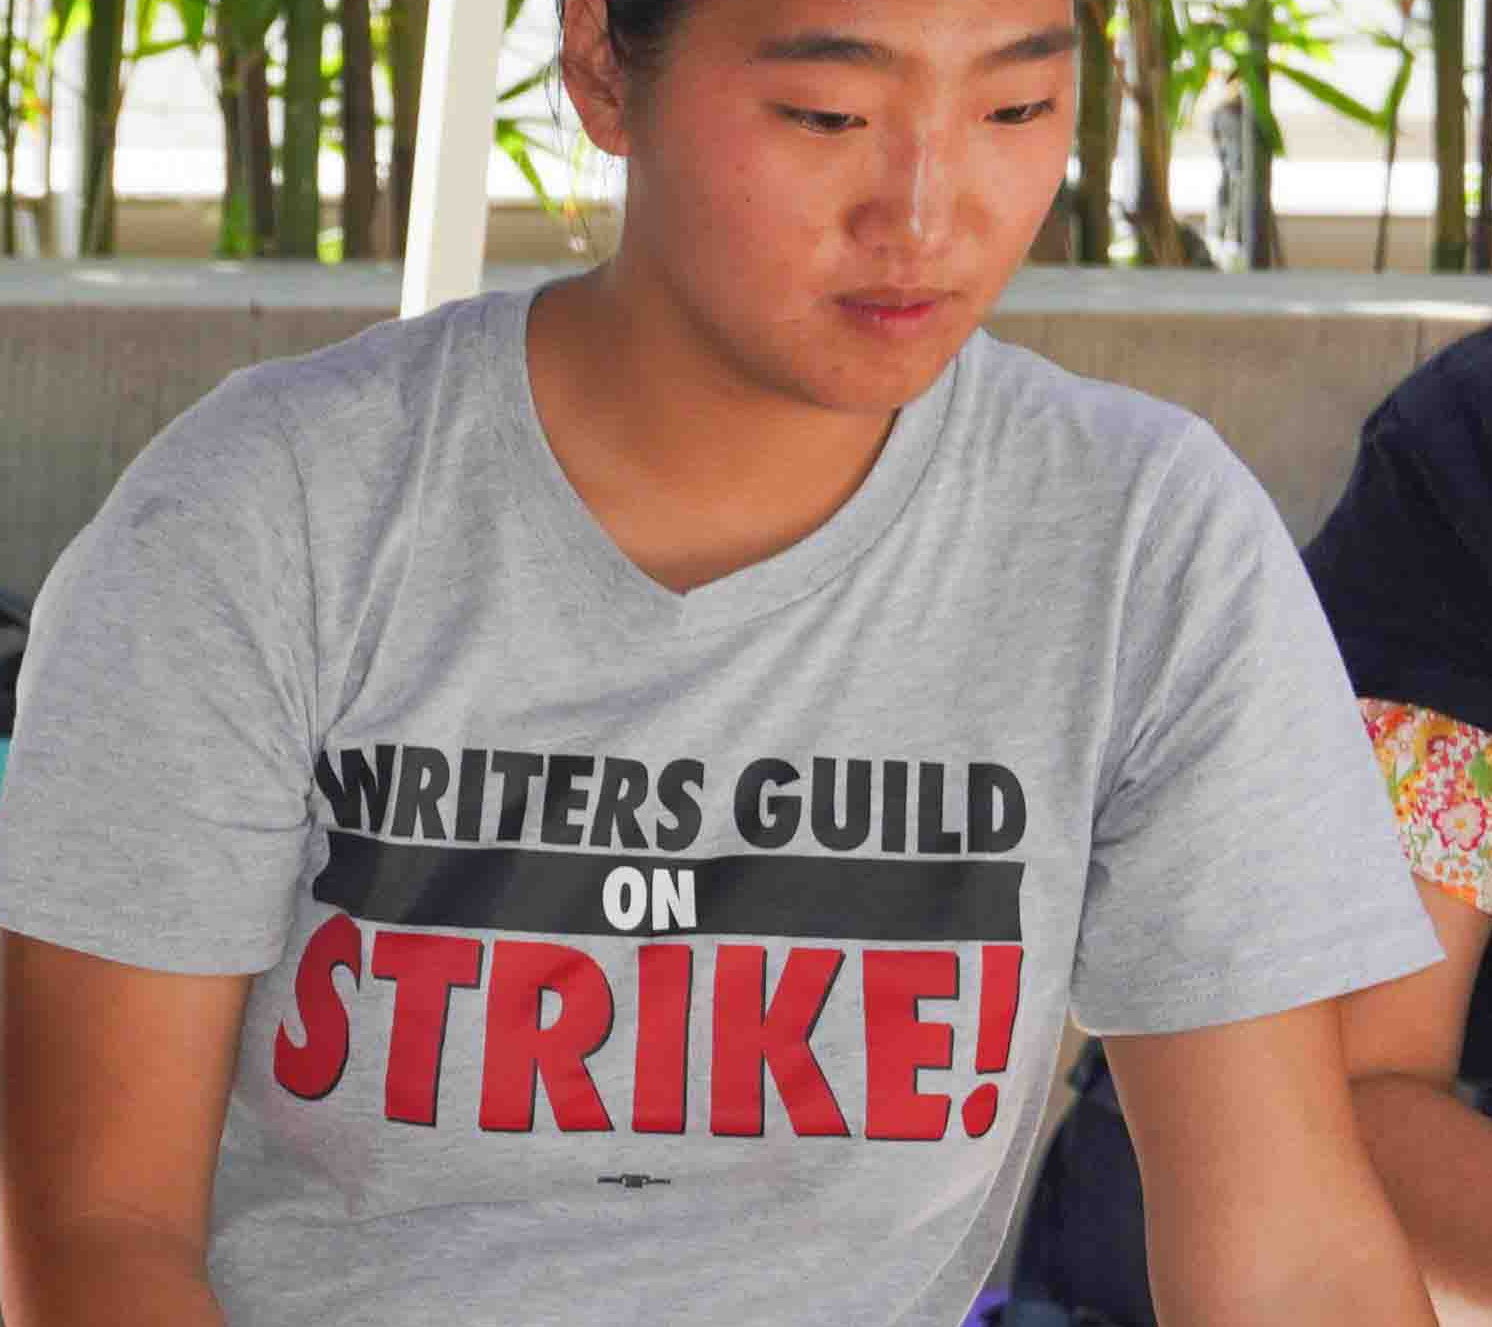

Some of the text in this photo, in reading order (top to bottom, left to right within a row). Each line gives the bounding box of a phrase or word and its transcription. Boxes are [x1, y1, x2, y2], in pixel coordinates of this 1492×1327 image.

[317, 744, 1028, 854] WRITERS GUILD
[602, 865, 698, 932] ON
[273, 912, 1025, 1141] STRIKE!
